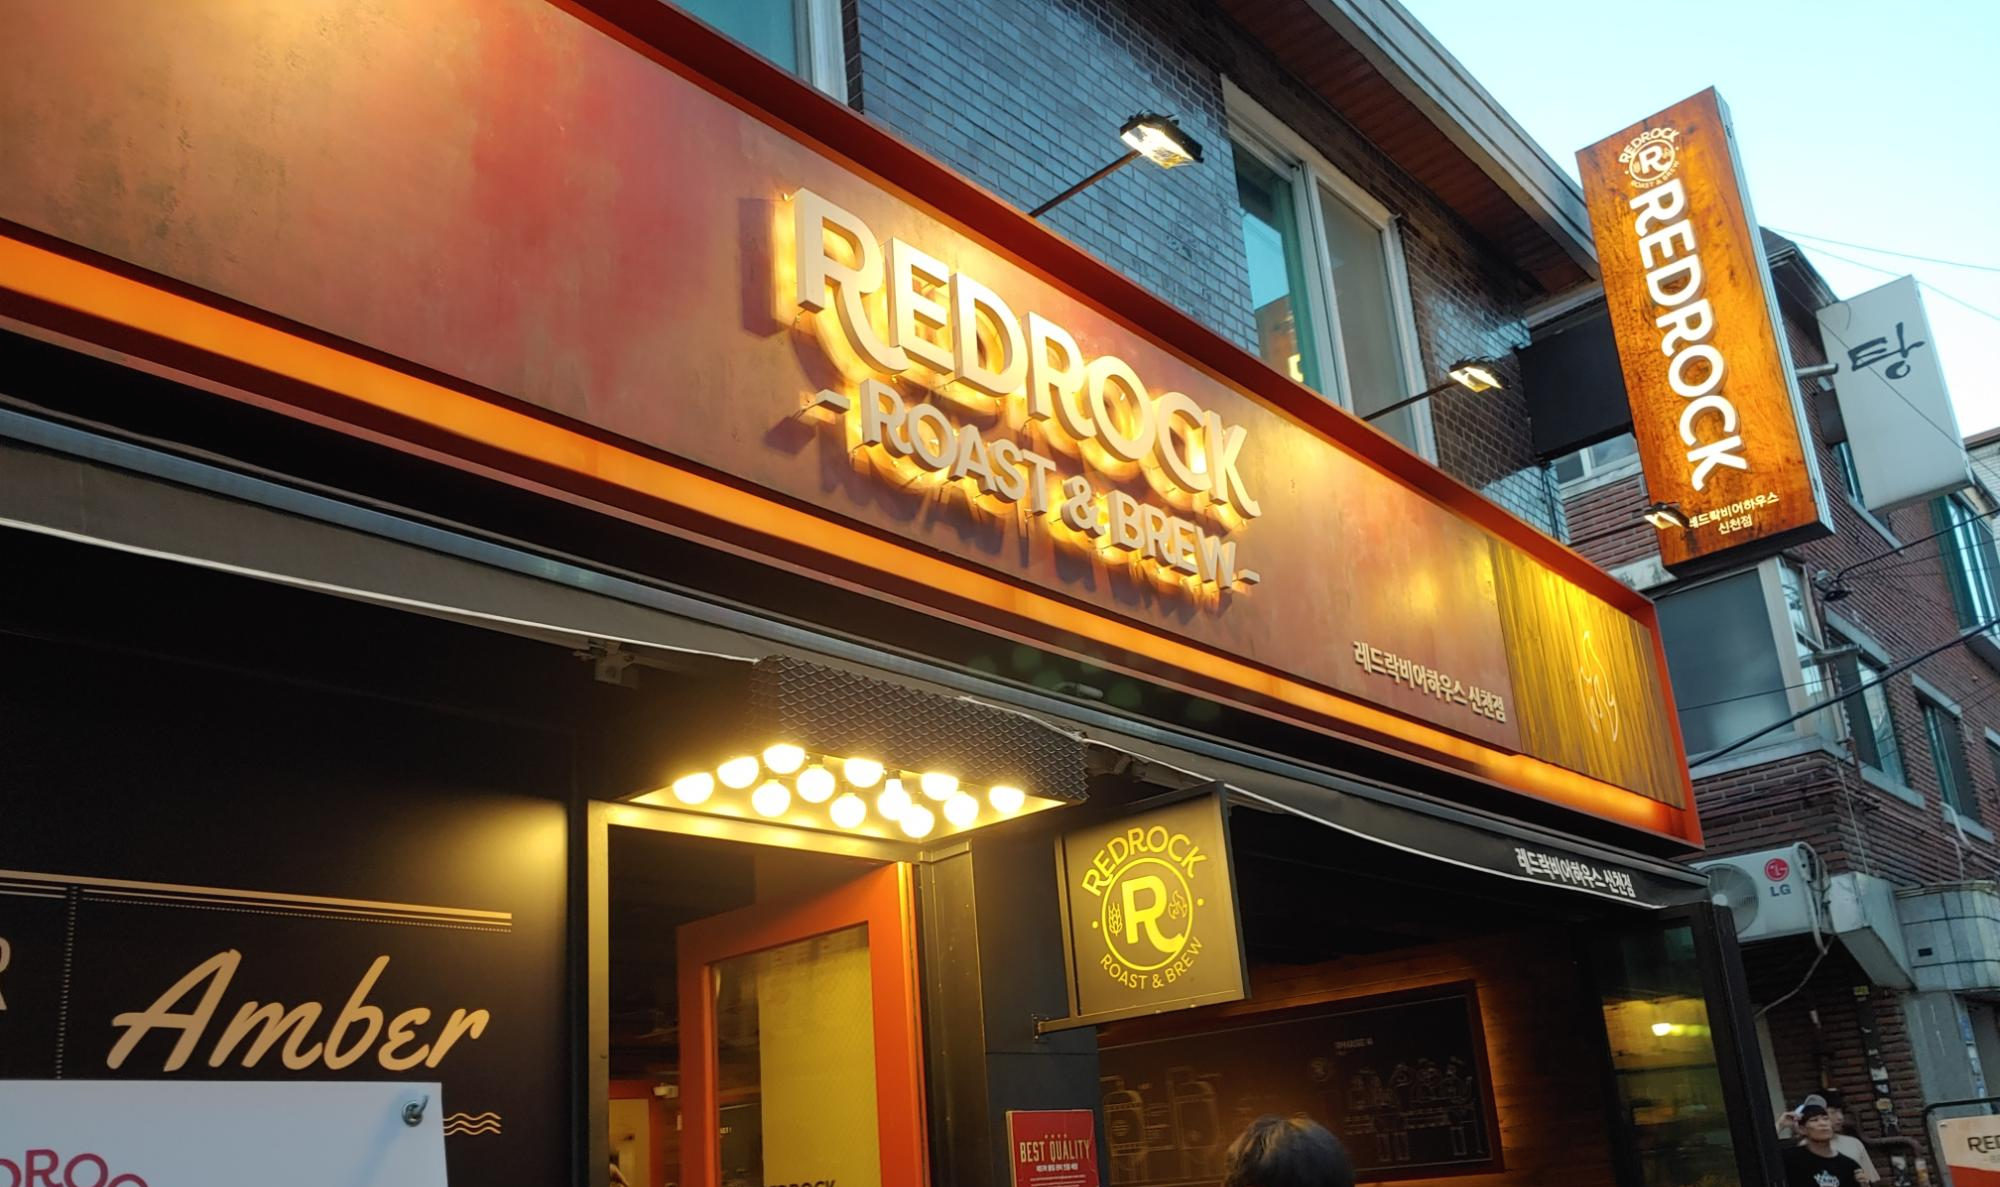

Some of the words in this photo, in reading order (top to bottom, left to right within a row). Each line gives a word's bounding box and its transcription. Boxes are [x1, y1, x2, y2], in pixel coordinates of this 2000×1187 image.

[1618, 127, 1680, 163] REDROCK
[796, 187, 1261, 520] REDROCK
[1629, 178, 1748, 492] REDROCK
[1848, 322, 1925, 379] 탕
[860, 378, 1056, 515] ROAST
[1061, 475, 1107, 538] &
[1108, 489, 1238, 590] BREW
[1689, 491, 1779, 528] 레드락비어하우스
[1718, 514, 1753, 535] 신천점
[1353, 640, 1468, 705] 레드락비어하우스
[1468, 685, 1507, 723] 신천점
[1081, 825, 1207, 897] REDROCK
[1514, 847, 1607, 888] 레드락비어하우스
[1603, 869, 1636, 898] 신천점
[1121, 875, 1185, 953] R
[1770, 884, 1792, 897] LG
[1100, 953, 1148, 990] ROAST
[1151, 973, 1164, 989] &
[1165, 936, 1203, 983] BREW
[106, 949, 490, 1072] Amber
[1019, 1141, 1045, 1163] BEST
[1049, 1139, 1090, 1163] QUALITY
